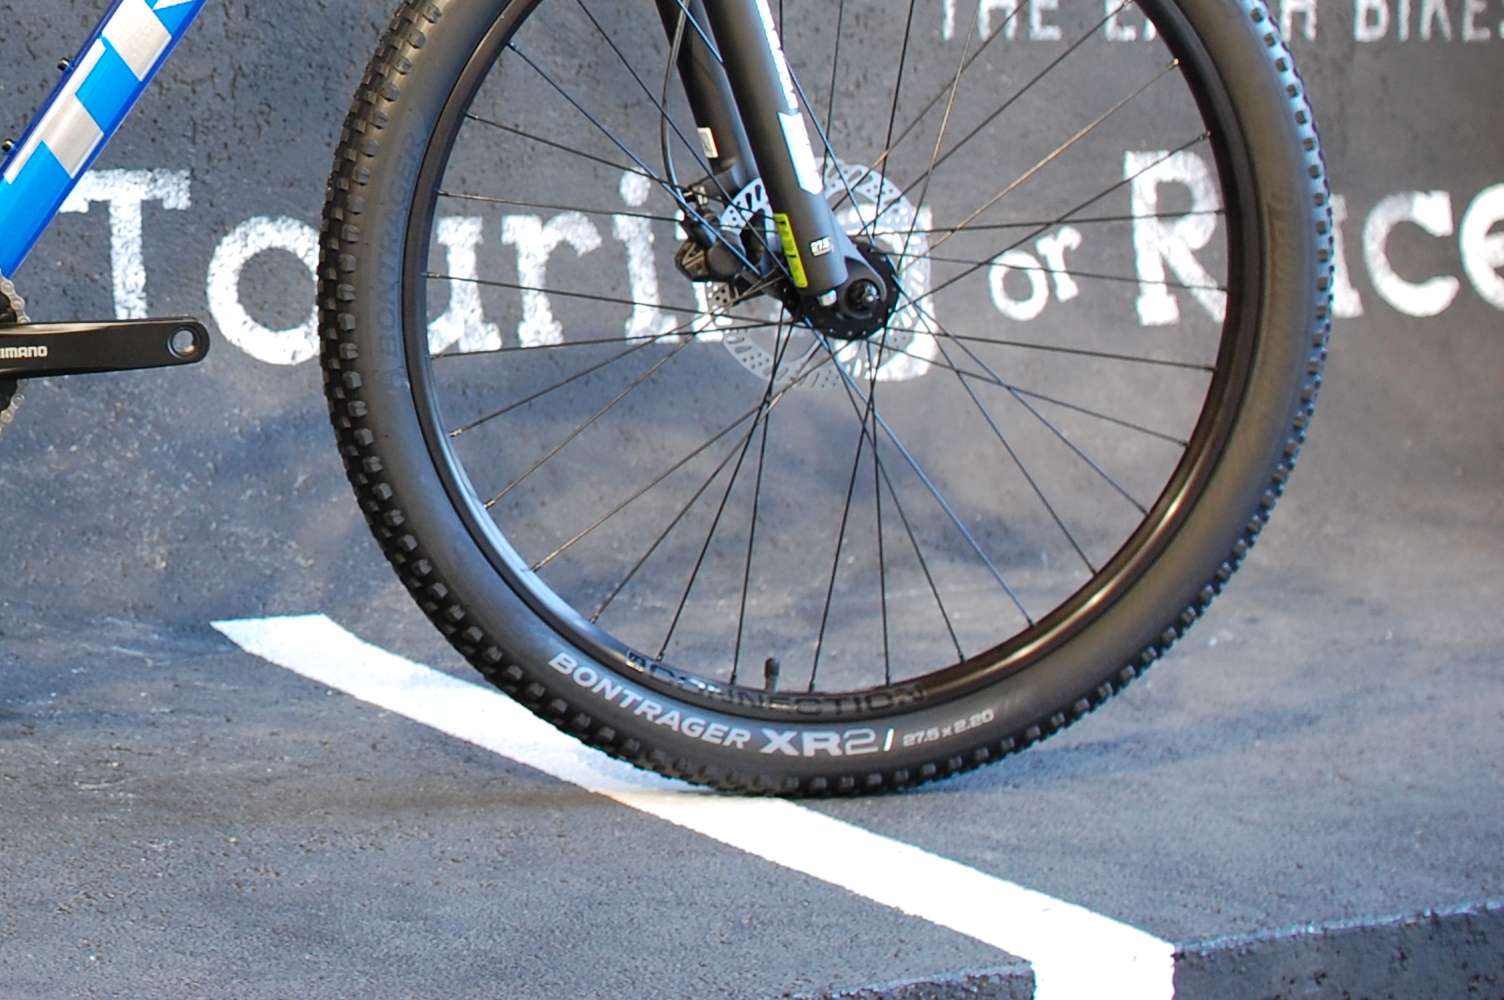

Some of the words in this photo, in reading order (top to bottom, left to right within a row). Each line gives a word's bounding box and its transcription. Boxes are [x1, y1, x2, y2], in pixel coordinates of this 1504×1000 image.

[987, 220, 1083, 322] or
[1123, 149, 1504, 329] Rce
[548, 651, 752, 750] BONTRAGER
